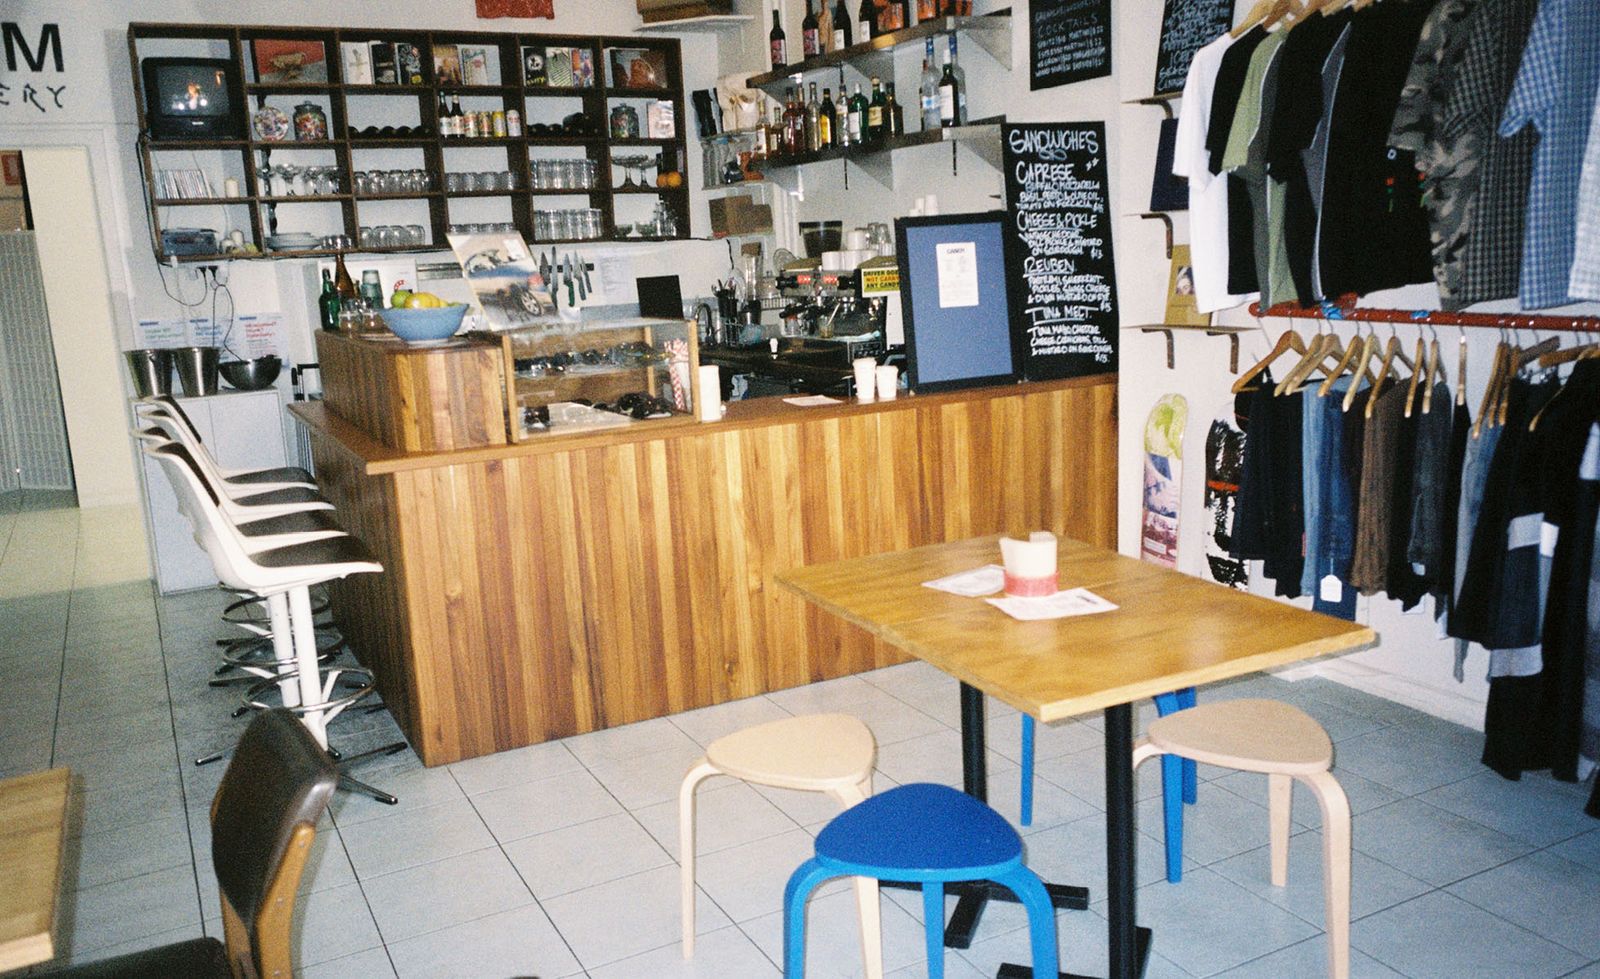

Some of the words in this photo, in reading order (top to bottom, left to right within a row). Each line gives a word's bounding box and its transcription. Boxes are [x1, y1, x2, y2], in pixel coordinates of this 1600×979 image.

[1009, 129, 1099, 154] SANDWICHES
[1017, 210, 1055, 231] CHEESE
[1056, 213, 1064, 228] &
[1064, 212, 1097, 228] PICKLE
[1025, 306, 1060, 323] TUNA
